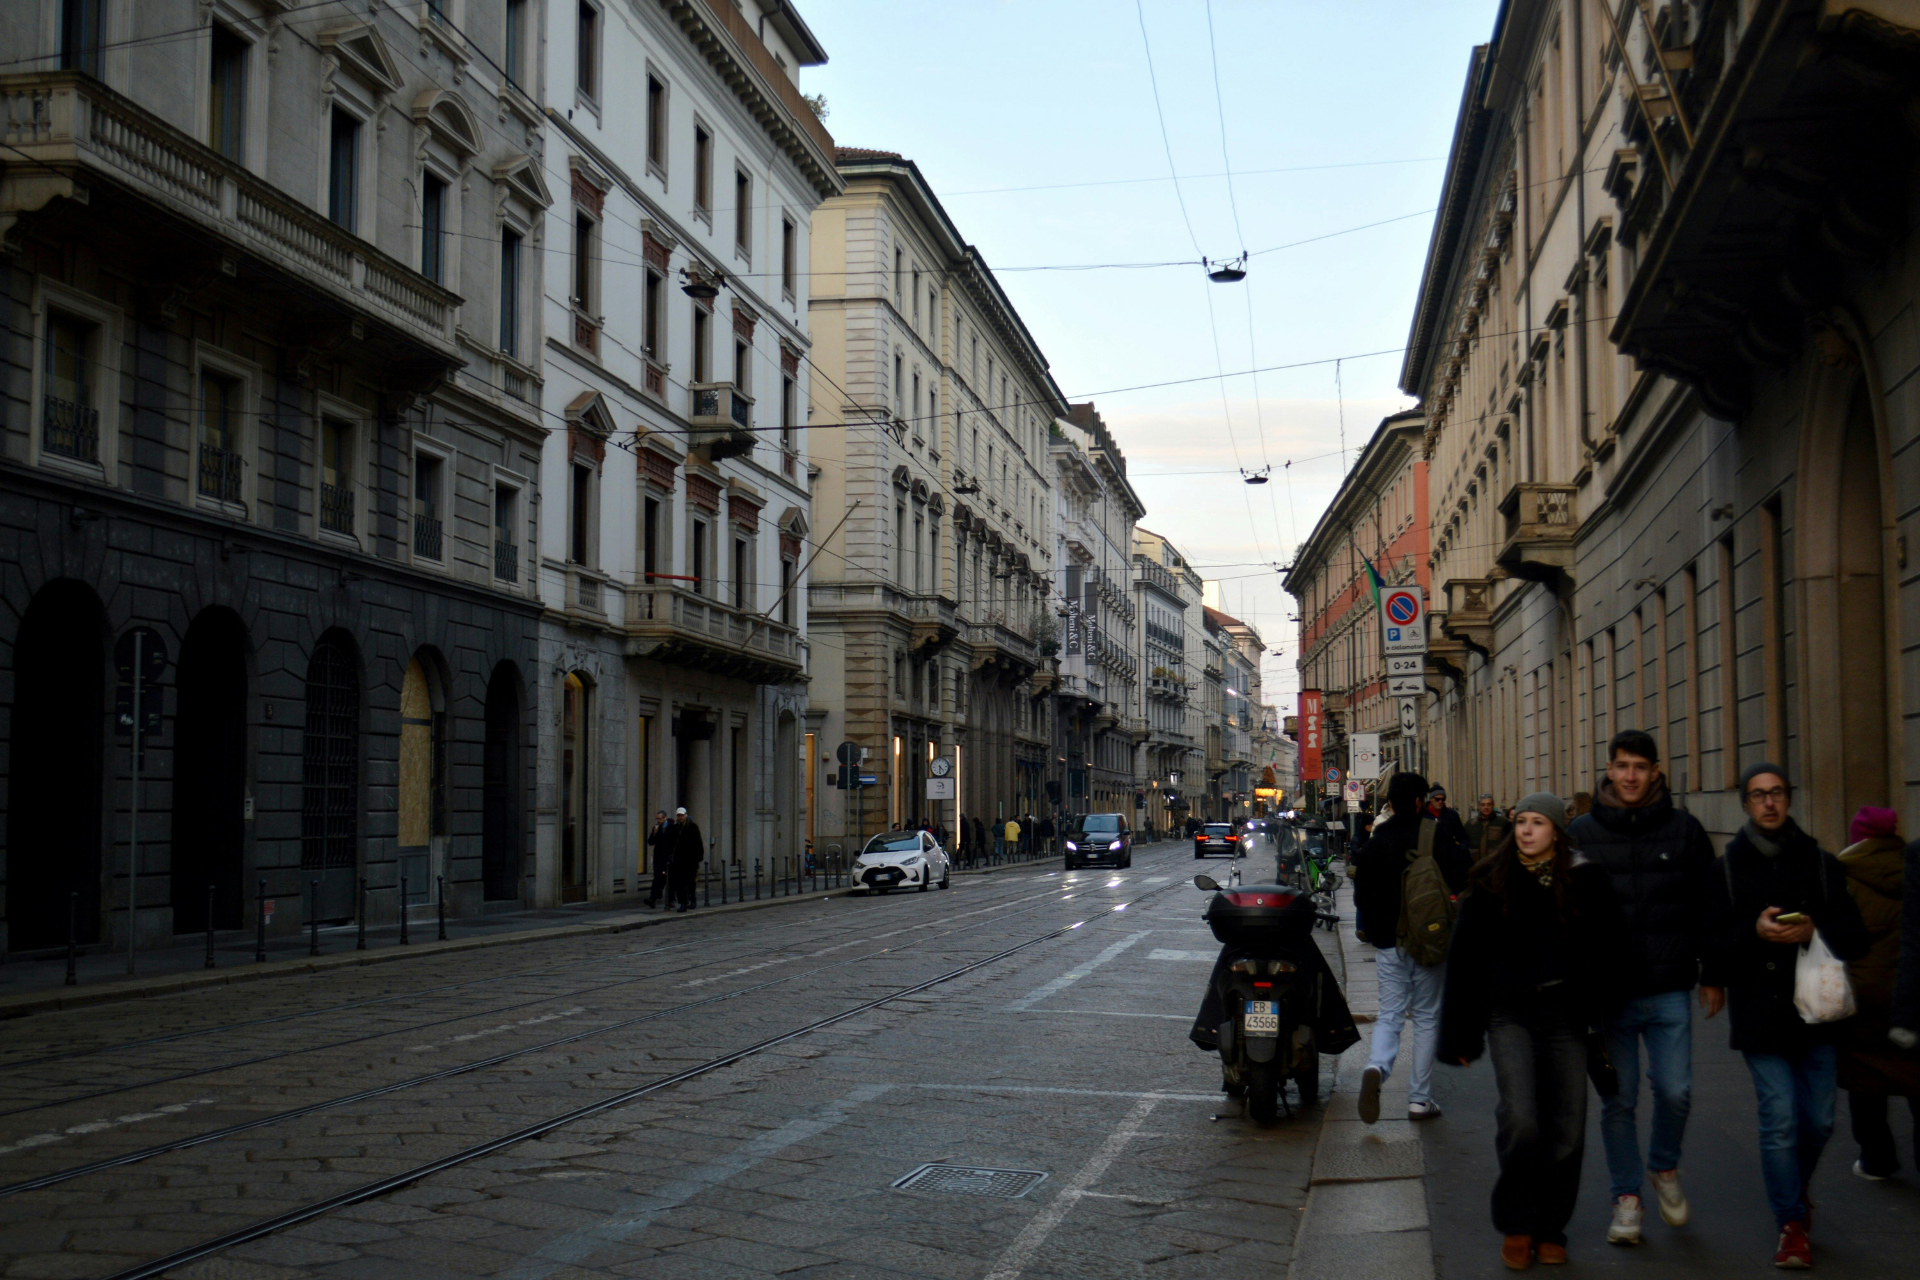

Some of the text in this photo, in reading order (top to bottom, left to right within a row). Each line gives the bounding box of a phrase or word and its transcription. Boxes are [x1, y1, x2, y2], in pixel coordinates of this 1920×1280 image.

[1390, 630, 1398, 639] P
[1394, 661, 1416, 670] 0-24
[1253, 1002, 1266, 1012] EB
[1246, 1016, 1276, 1028] 43566
